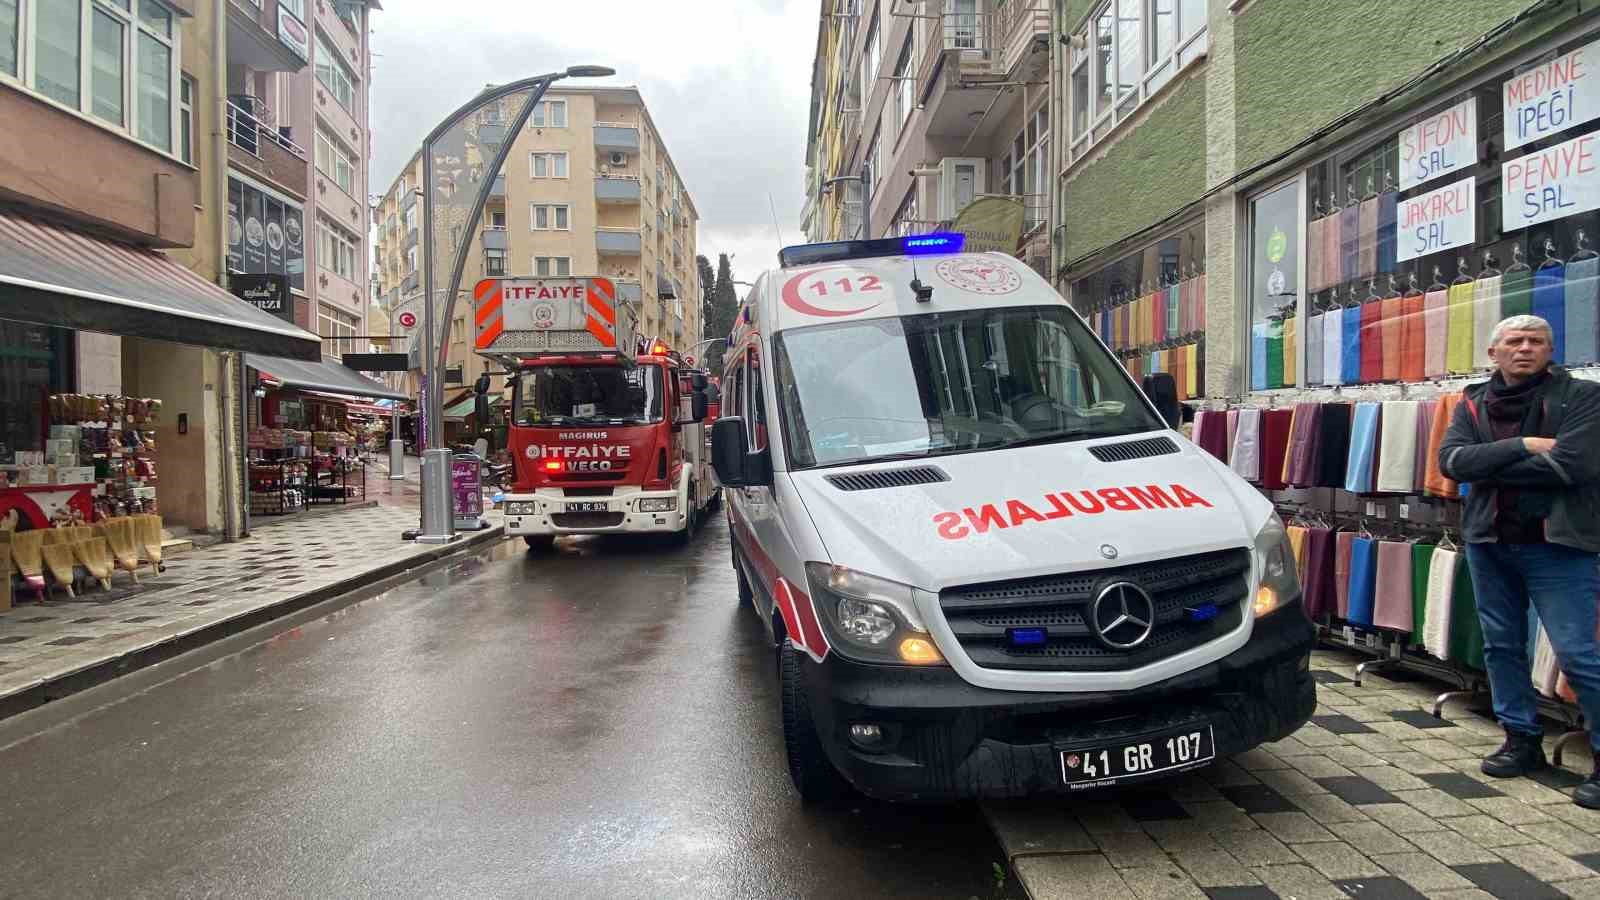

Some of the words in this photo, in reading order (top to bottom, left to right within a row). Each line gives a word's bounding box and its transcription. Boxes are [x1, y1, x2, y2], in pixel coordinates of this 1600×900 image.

[1507, 136, 1596, 195] PENYE
[1523, 184, 1576, 224] ŞAL
[809, 275, 884, 296] 112
[558, 431, 608, 440] MAGIRUS
[1083, 750, 1110, 777] 41
[1124, 743, 1154, 772] GR
[1166, 732, 1201, 763] 107
